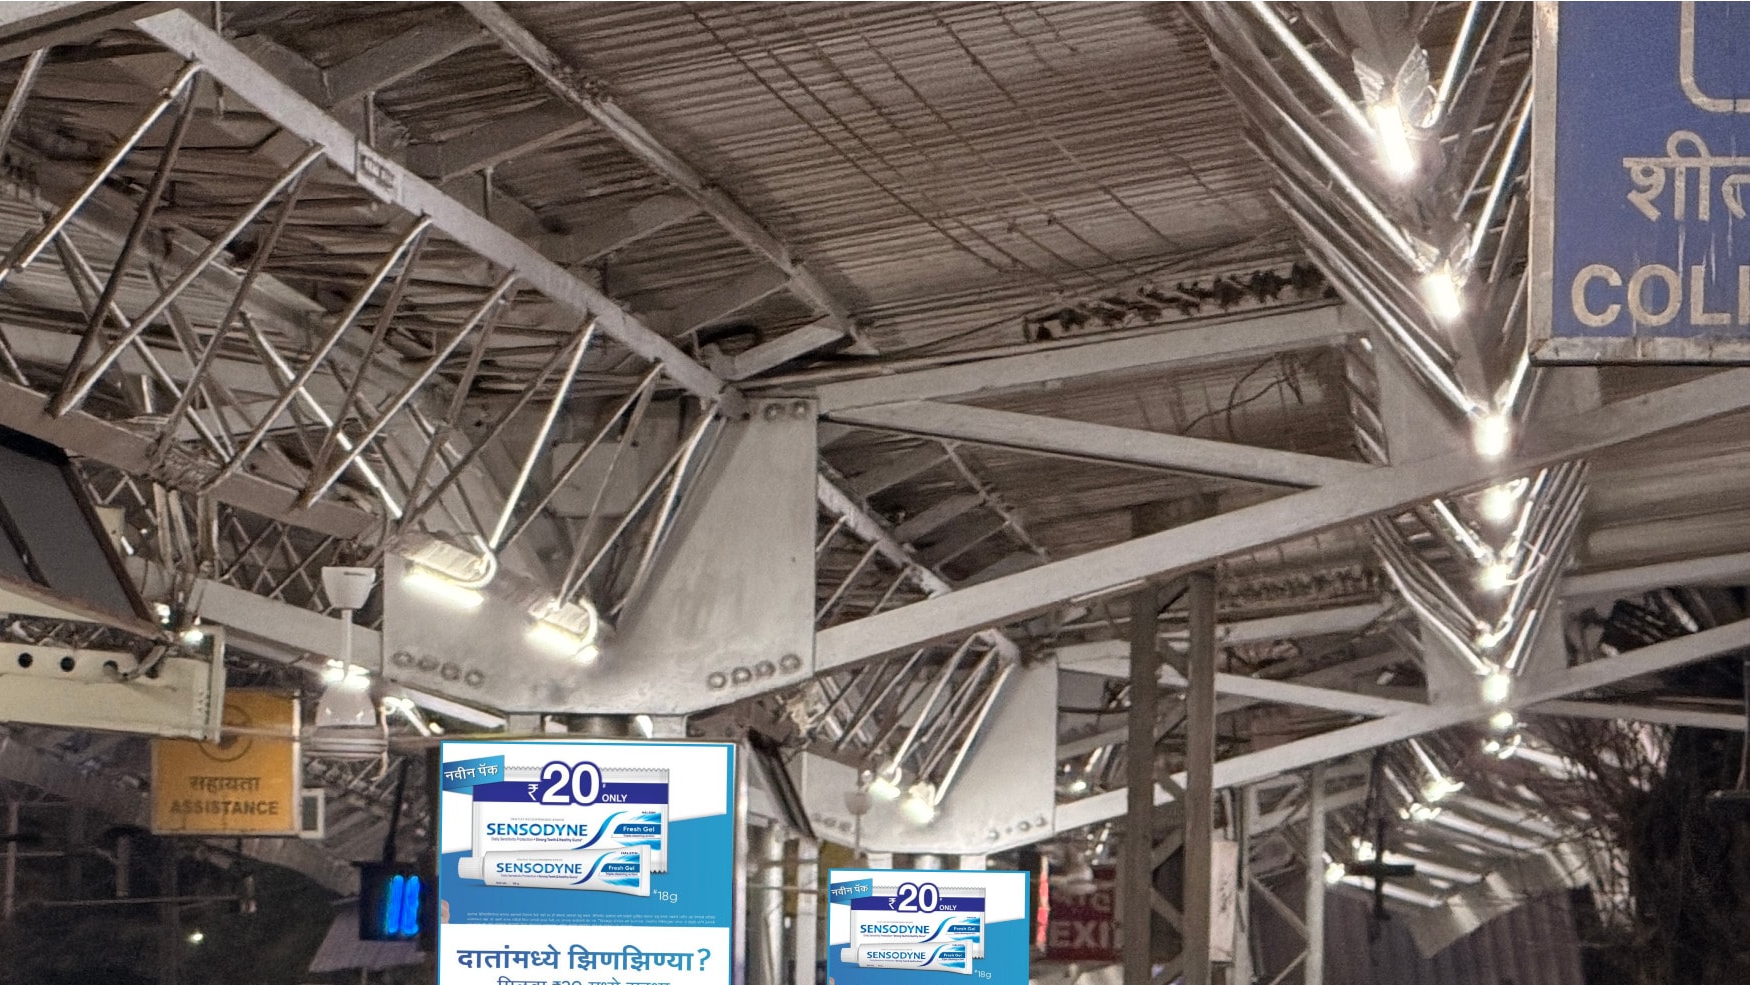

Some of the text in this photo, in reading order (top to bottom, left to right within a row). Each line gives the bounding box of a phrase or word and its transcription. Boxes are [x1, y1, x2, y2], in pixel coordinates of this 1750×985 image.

[444, 767, 476, 782] नवीन
[602, 794, 628, 802] ONLY
[170, 801, 279, 817] ASSISTANCE
[486, 823, 588, 837] SENSODYNE
[496, 863, 583, 874] SENSODYNE
[831, 886, 853, 897] नवीन
[860, 924, 930, 934] SENSODYNE
[456, 944, 561, 970] दातांमध्ये
[866, 951, 926, 960] SENSODYNE
